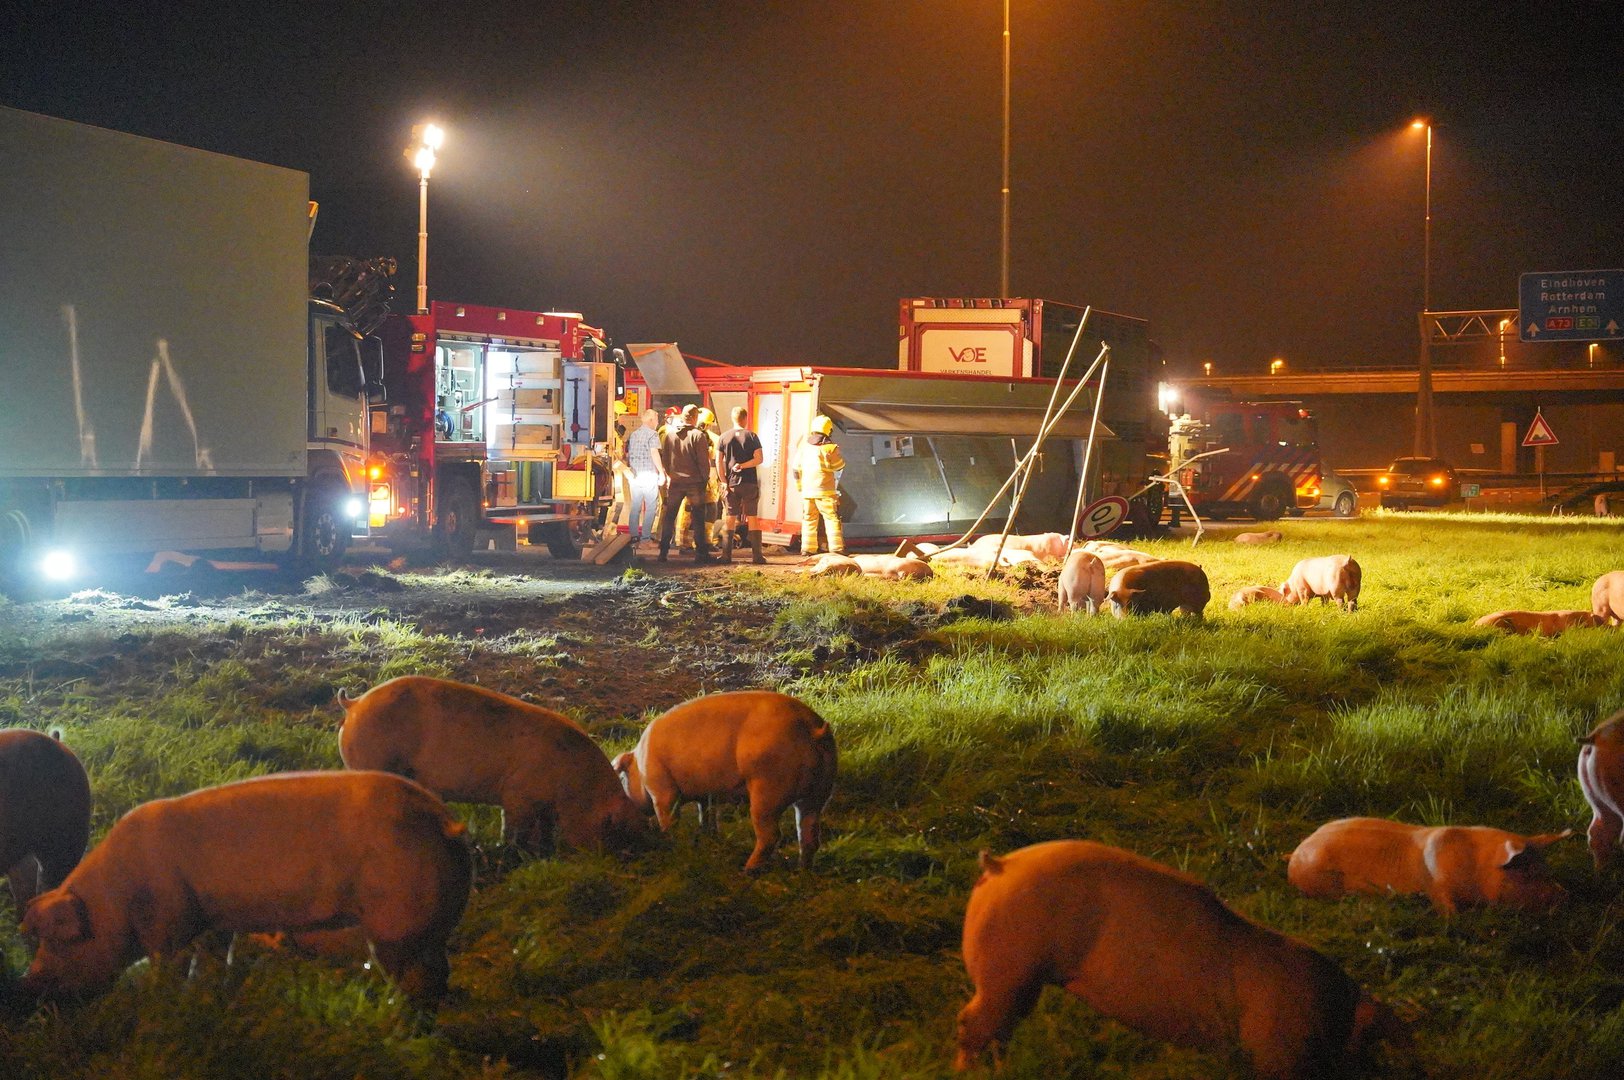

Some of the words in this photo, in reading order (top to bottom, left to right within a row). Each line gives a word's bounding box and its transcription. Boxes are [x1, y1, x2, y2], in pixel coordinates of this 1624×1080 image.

[1541, 278, 1605, 289] Eindhoven
[1541, 291, 1605, 301] Rotterdam
[1549, 304, 1597, 314] Arnhem
[1549, 319, 1570, 328] A73
[1091, 505, 1116, 534] 70
